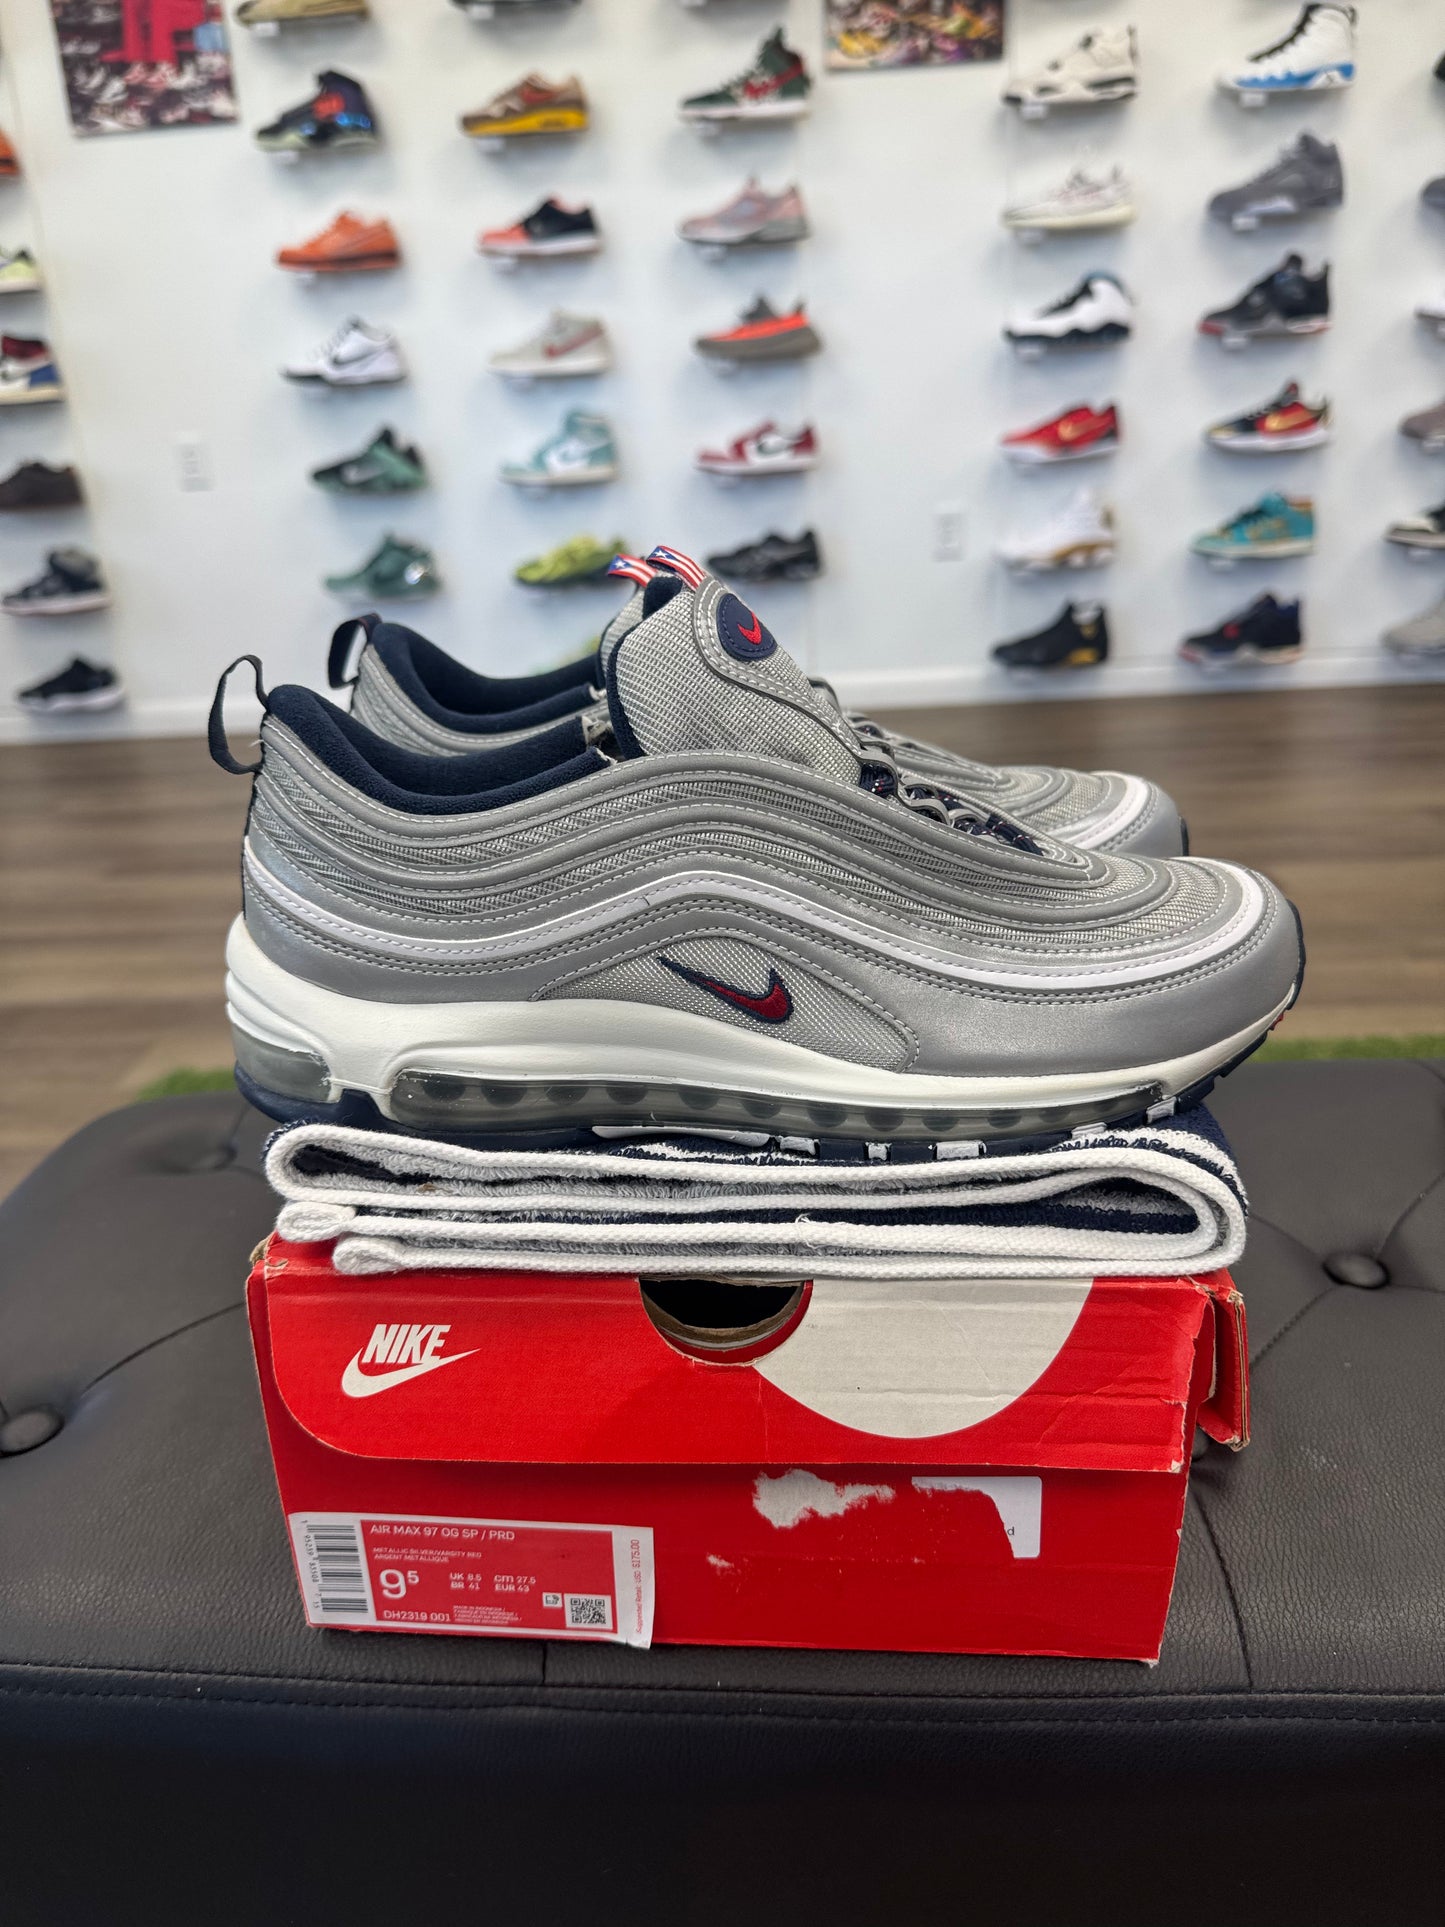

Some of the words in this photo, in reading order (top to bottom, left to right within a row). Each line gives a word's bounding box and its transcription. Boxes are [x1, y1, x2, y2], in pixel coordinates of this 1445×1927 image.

[361, 1324, 451, 1363] NIKE
[370, 1524, 391, 1535] AIR
[394, 1525, 421, 1536] MAX
[423, 1526, 438, 1537] 97
[441, 1527, 460, 1538] OG
[462, 1528, 479, 1539] SP
[489, 1530, 515, 1541] PRD
[450, 1572, 465, 1581] UK
[451, 1581, 465, 1589] BR
[495, 1584, 515, 1592] EUR
[383, 1610, 428, 1621] DH2319
[430, 1612, 450, 1622] 001
